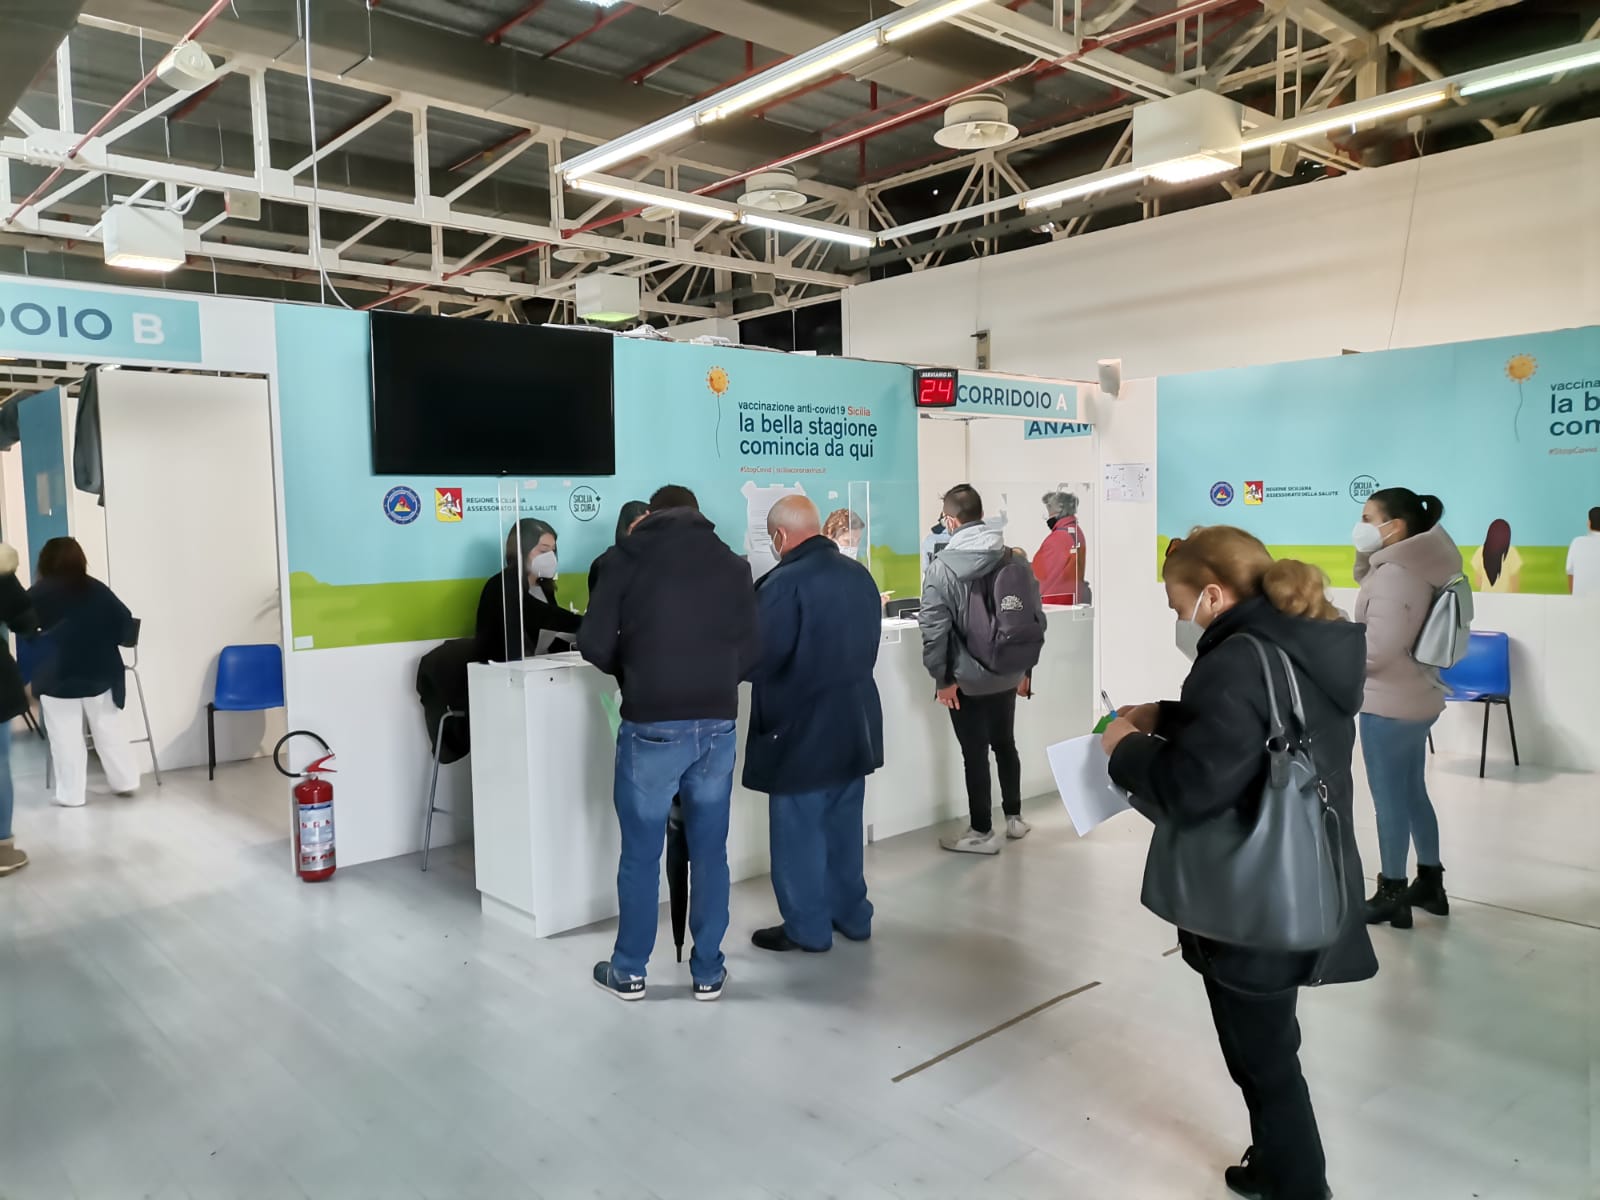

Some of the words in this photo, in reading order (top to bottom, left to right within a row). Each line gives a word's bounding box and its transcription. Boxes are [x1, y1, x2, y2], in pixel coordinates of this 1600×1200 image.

[0, 302, 113, 341] OIO
[131, 312, 166, 345] B
[920, 379, 952, 402] 24
[957, 384, 1052, 409] CORRIDOIO
[1055, 392, 1068, 411] A
[738, 400, 795, 413] vaccinazione
[797, 404, 846, 415] anti-covid19
[847, 406, 871, 417] Sicilia
[1551, 393, 1573, 414] la
[739, 412, 755, 433] la
[761, 414, 803, 435] bella
[808, 417, 878, 440] stagione
[740, 436, 819, 456] comincia
[825, 438, 844, 457] da
[849, 440, 873, 461] qui
[573, 495, 593, 504] SICILIA
[573, 504, 581, 512] SI
[583, 504, 596, 513] CURA
